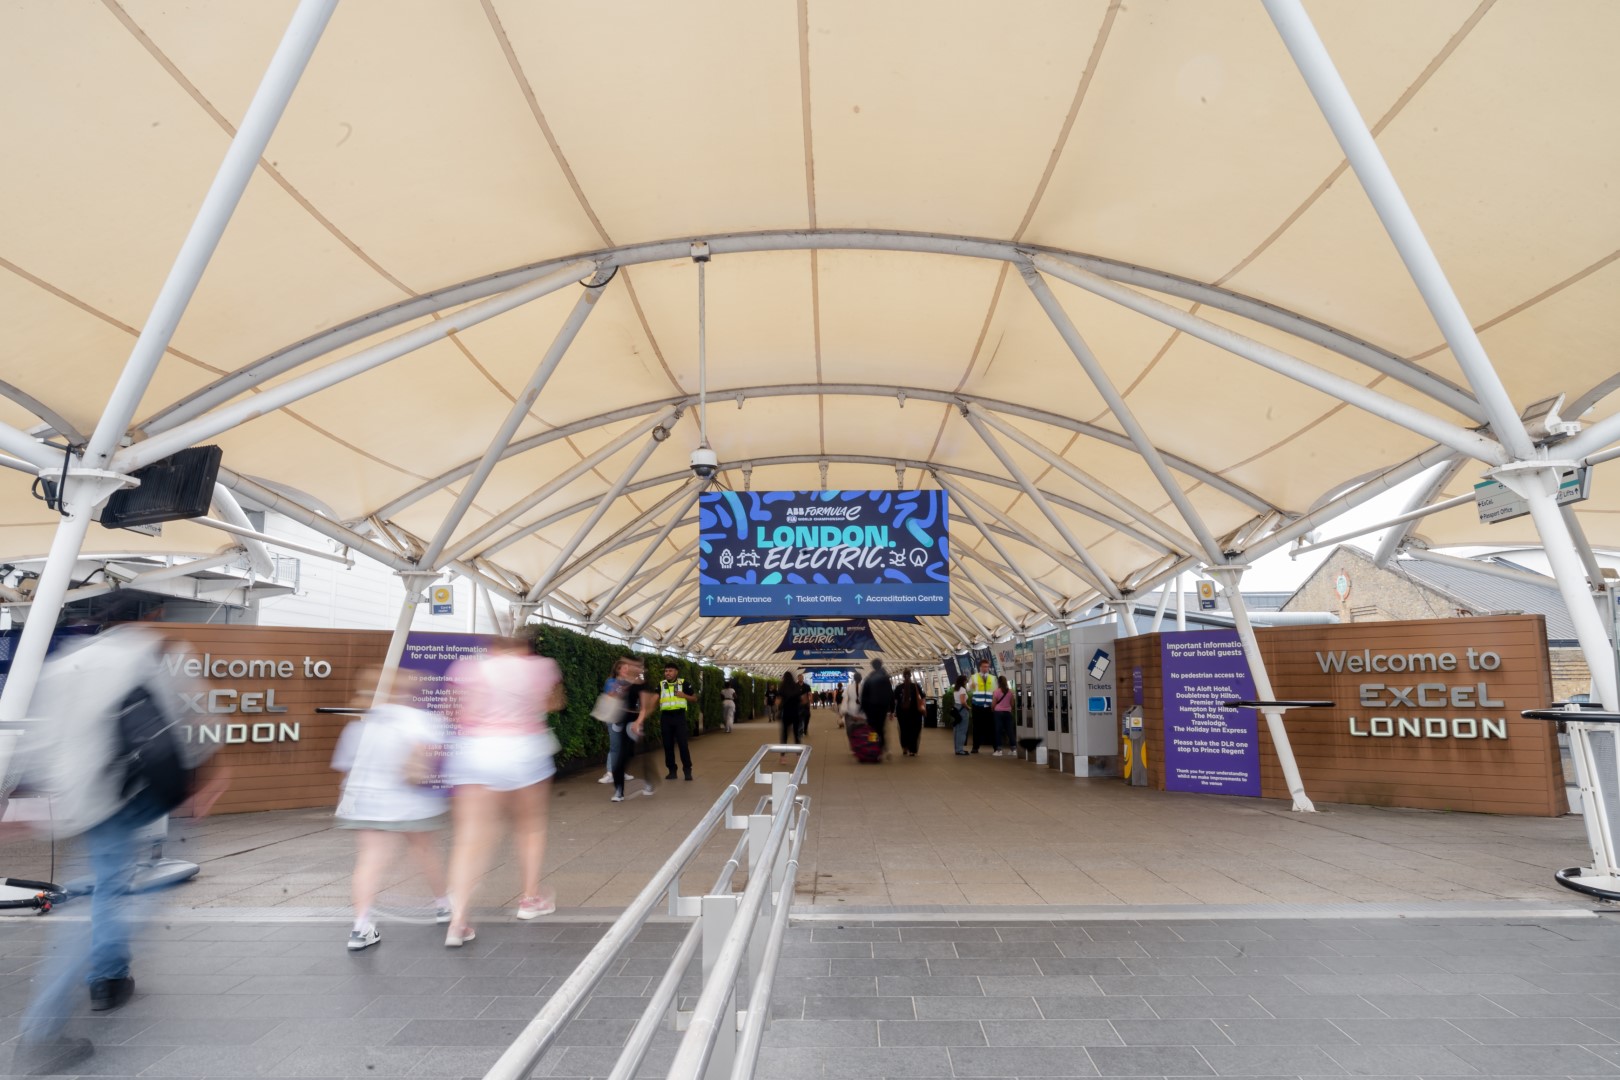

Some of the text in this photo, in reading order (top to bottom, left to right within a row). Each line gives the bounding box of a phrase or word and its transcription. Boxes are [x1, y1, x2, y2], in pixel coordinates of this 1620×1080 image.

[805, 506, 847, 516] FORMULA
[757, 525, 896, 548] LONDON.
[764, 544, 885, 570] ELECTRIC.
[792, 627, 846, 636] LONDON.
[792, 635, 835, 643] ELECTRIC.
[406, 644, 444, 652] Important
[1203, 641, 1243, 649] informatio
[159, 653, 332, 678] Welcome to
[1316, 648, 1500, 673] Welcome to
[1349, 717, 1508, 739] LONDON
